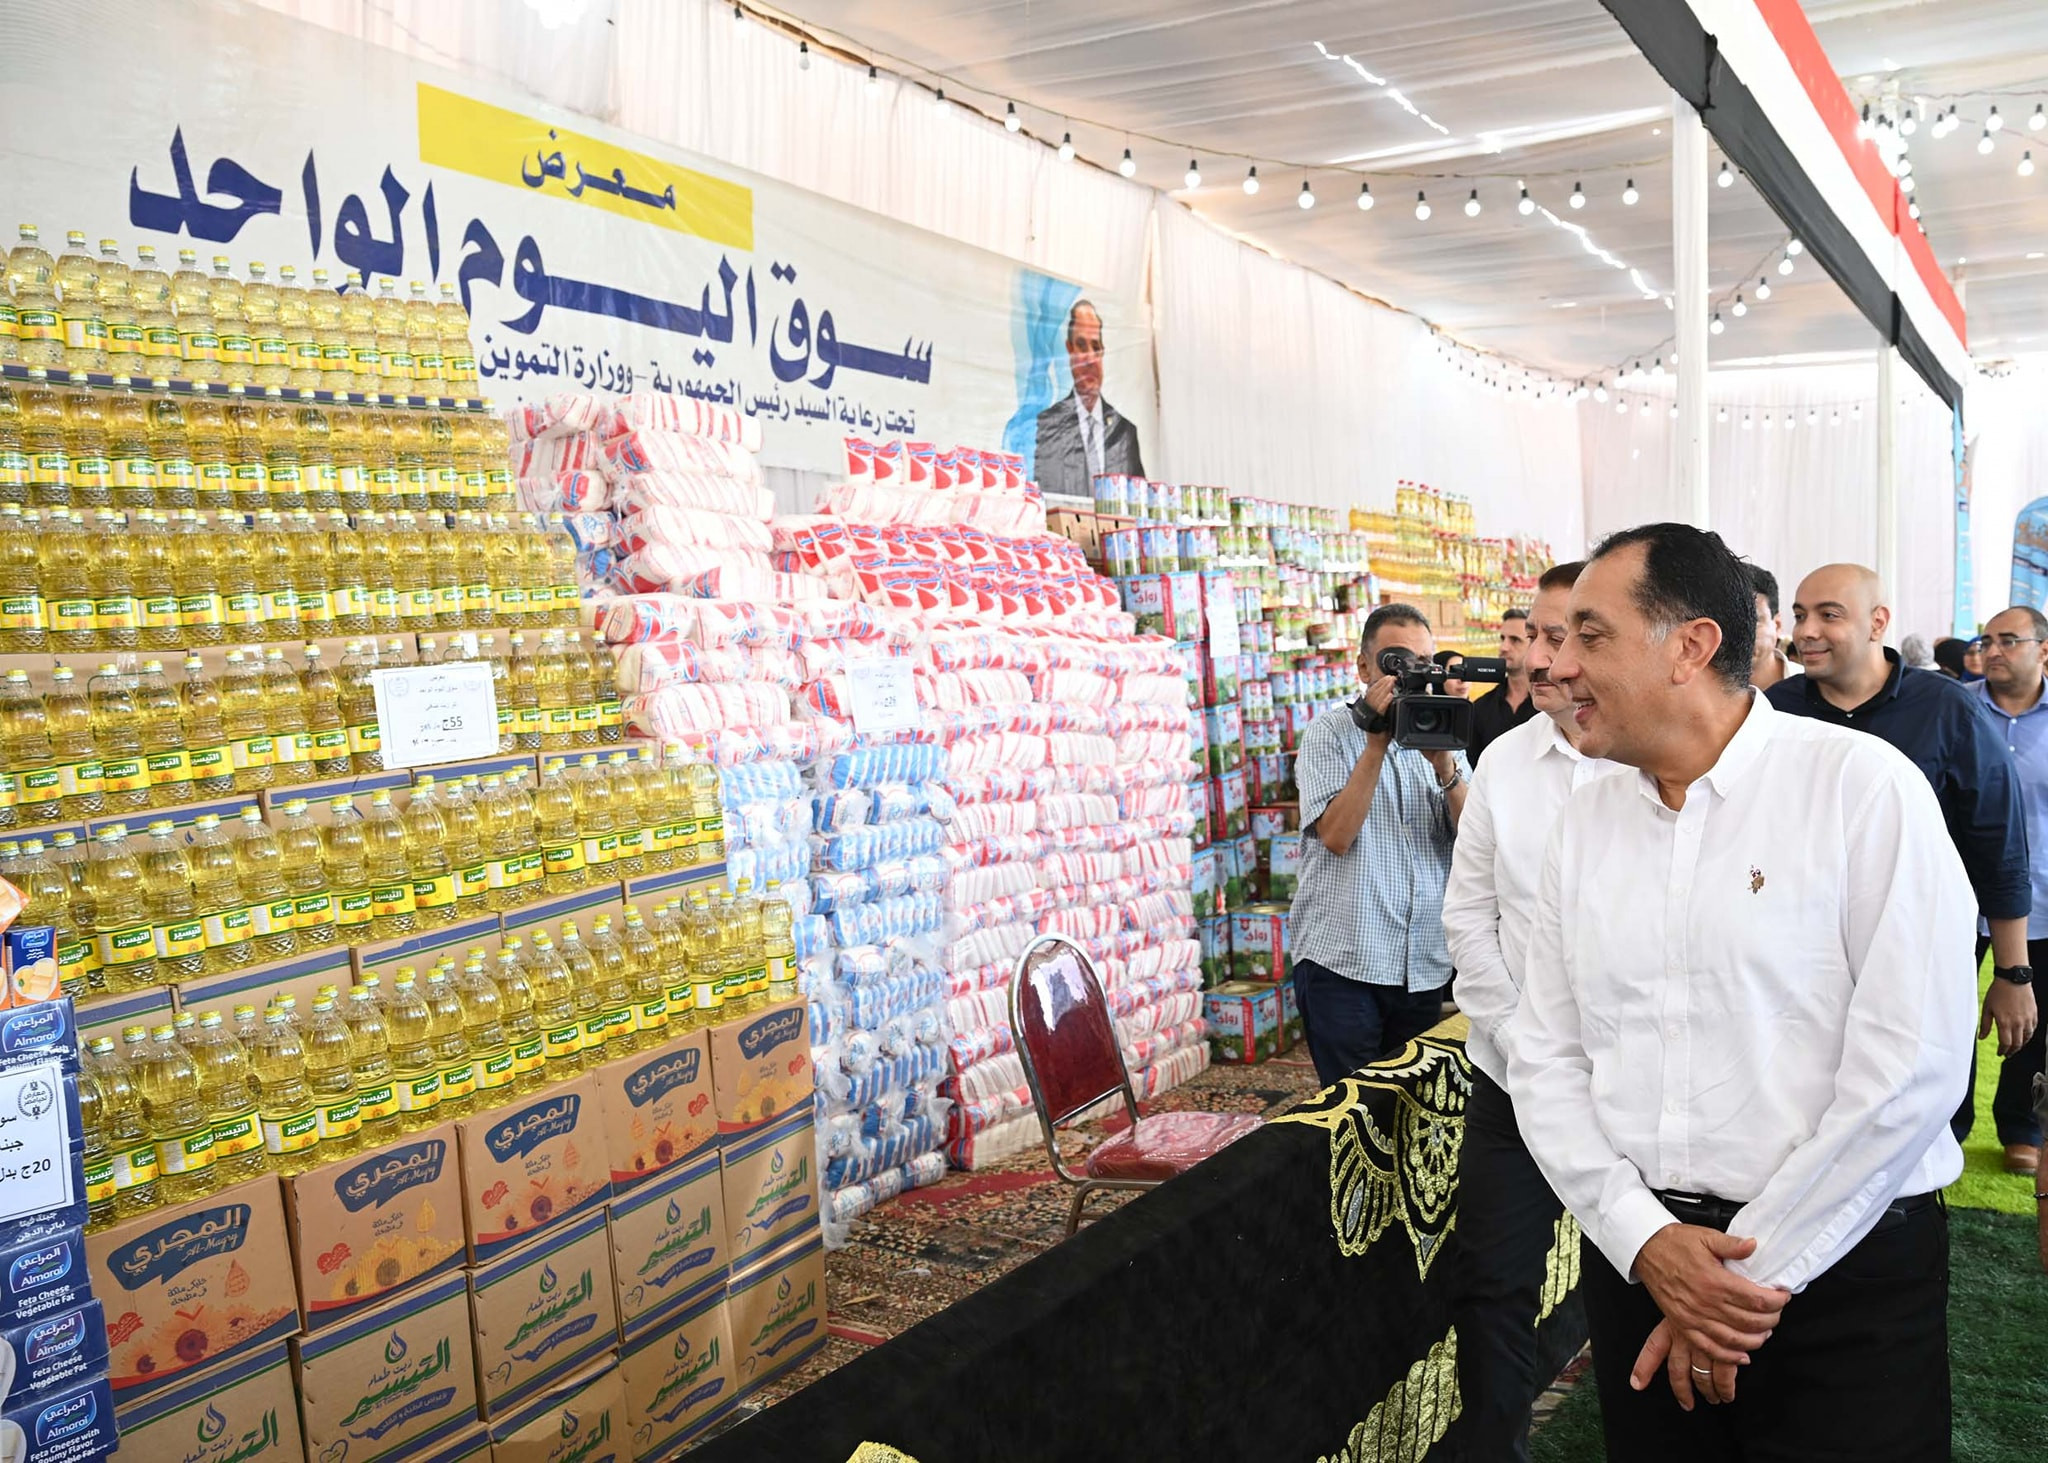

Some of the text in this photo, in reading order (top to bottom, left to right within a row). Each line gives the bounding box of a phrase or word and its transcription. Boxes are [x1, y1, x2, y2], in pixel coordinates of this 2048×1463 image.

[521, 128, 675, 209] معرض
[130, 123, 933, 390] سوق اليوم الواحد
[480, 335, 569, 380] التموين
[745, 383, 789, 421] رئيس
[795, 394, 836, 425] السيد
[840, 396, 881, 435] رعاية
[885, 409, 915, 434] تحت
[149, 758, 179, 769] التيسير
[300, 900, 328, 912] التيسير
[374, 891, 402, 901] التيسير
[117, 931, 150, 946] التيسير
[11, 1013, 53, 1030] المراعي
[744, 1009, 799, 1050] المجري
[14, 1030, 56, 1047] Almarai
[632, 1050, 695, 1096] المجري
[360, 1089, 390, 1104] التيسير
[0, 1114, 17, 1127] سو
[214, 1123, 249, 1139] التيسير
[494, 1097, 573, 1151] المجري
[0, 1138, 24, 1152] جبن
[346, 1143, 438, 1199] المجري
[392, 1166, 436, 1190] Al-Magry
[123, 1207, 241, 1275] المجري
[181, 1233, 238, 1262] Al-Magry
[637, 1204, 712, 1276] التيسير
[19, 1248, 60, 1269] المراعي
[21, 1264, 64, 1287] Almarai
[16, 1293, 75, 1319] Vegetable Fat
[18, 1285, 70, 1307] Feta Cheese
[504, 1267, 593, 1351] التيسير
[34, 1317, 75, 1341] المراعي
[36, 1334, 77, 1358] Almarai
[33, 1354, 83, 1378] Feta Cheese
[368, 1359, 413, 1390] زيت طعام
[645, 1335, 720, 1413] التيسير
[340, 1336, 451, 1427] التيسير
[45, 1398, 86, 1422] المراعي
[47, 1414, 89, 1440] Almarai
[30, 1428, 100, 1461] Feta Cheese with
[69, 1439, 93, 1454] Flavor
